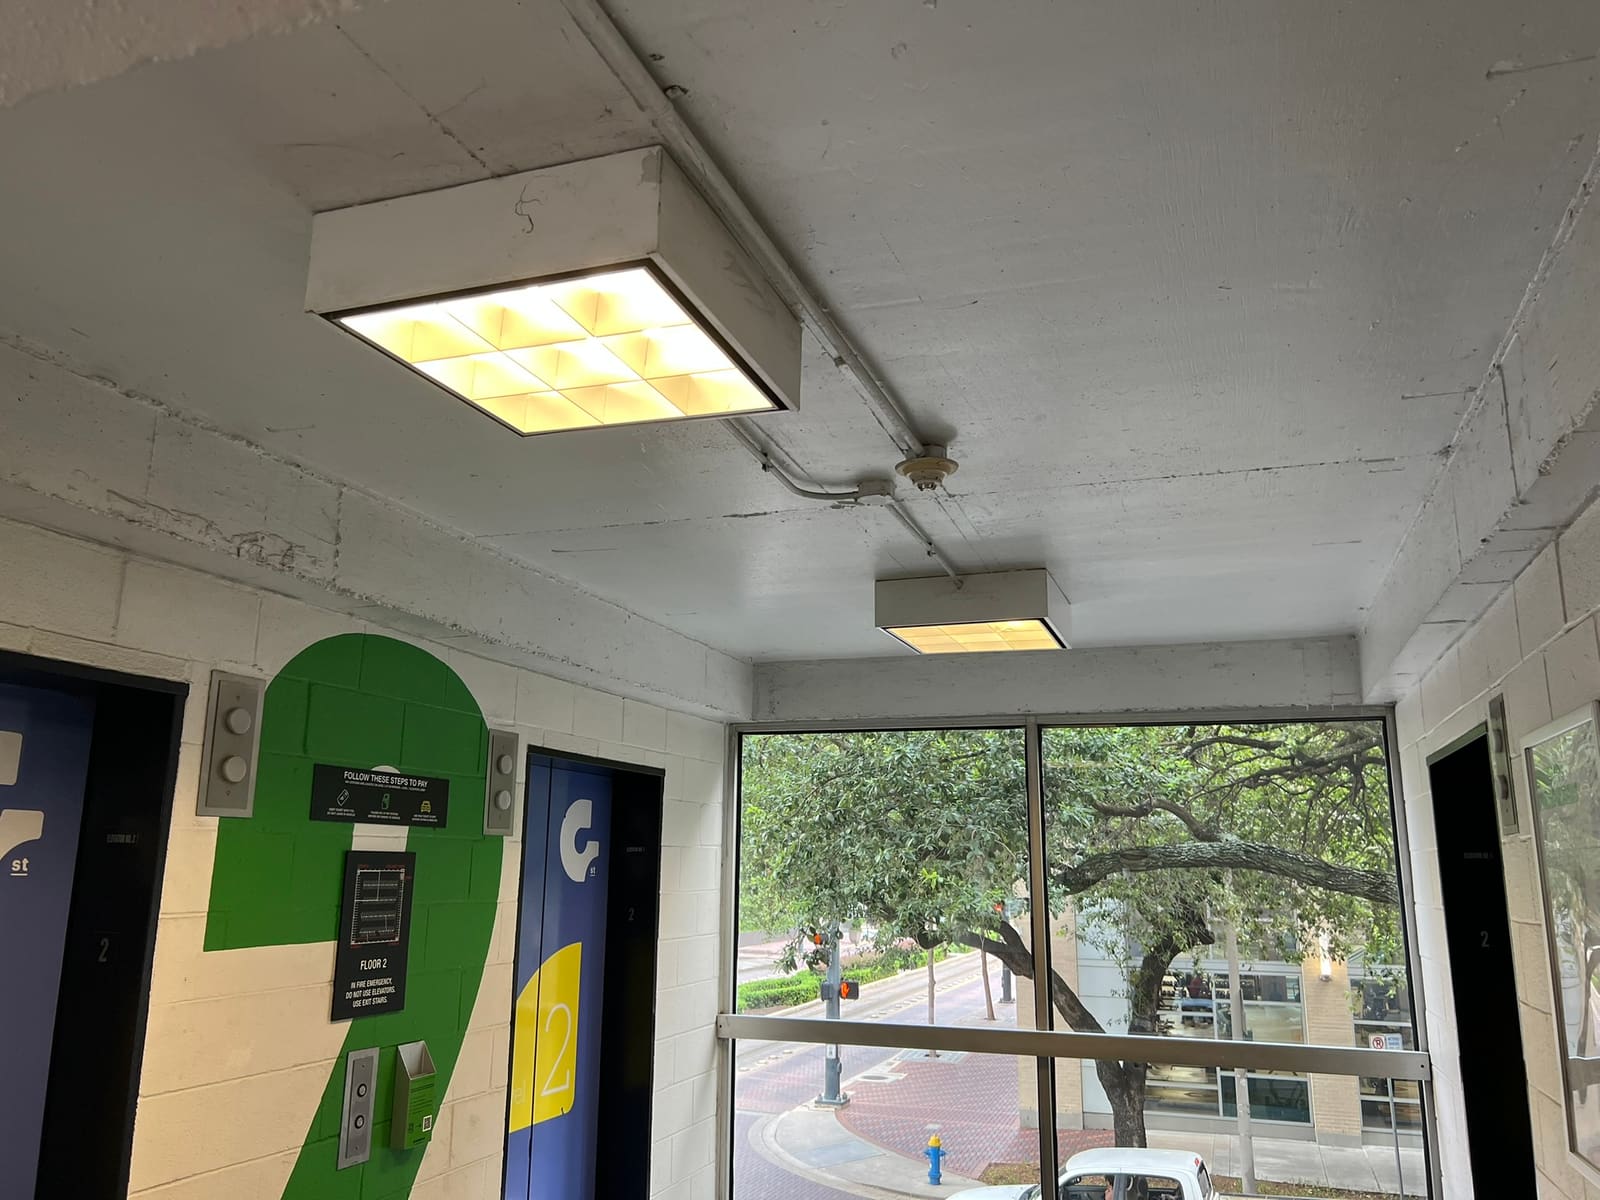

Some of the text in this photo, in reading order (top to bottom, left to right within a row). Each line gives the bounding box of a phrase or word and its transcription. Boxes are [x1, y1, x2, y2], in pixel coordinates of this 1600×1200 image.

[344, 771, 370, 781] FOLLOW
[371, 774, 389, 784] THESE
[390, 776, 408, 786] STEPS
[409, 778, 417, 787] TO
[417, 779, 429, 788] PAY
[11, 857, 29, 873] st
[1480, 930, 1490, 948] 2
[98, 938, 109, 962] 2
[360, 958, 387, 970] FLOOR 2
[356, 980, 366, 988] FIRE
[345, 991, 353, 999] DO
[353, 990, 362, 998] NOT
[362, 989, 371, 997] USE
[352, 999, 361, 1008] USE
[362, 998, 372, 1006] EXIT
[540, 1002, 572, 1097] 2
